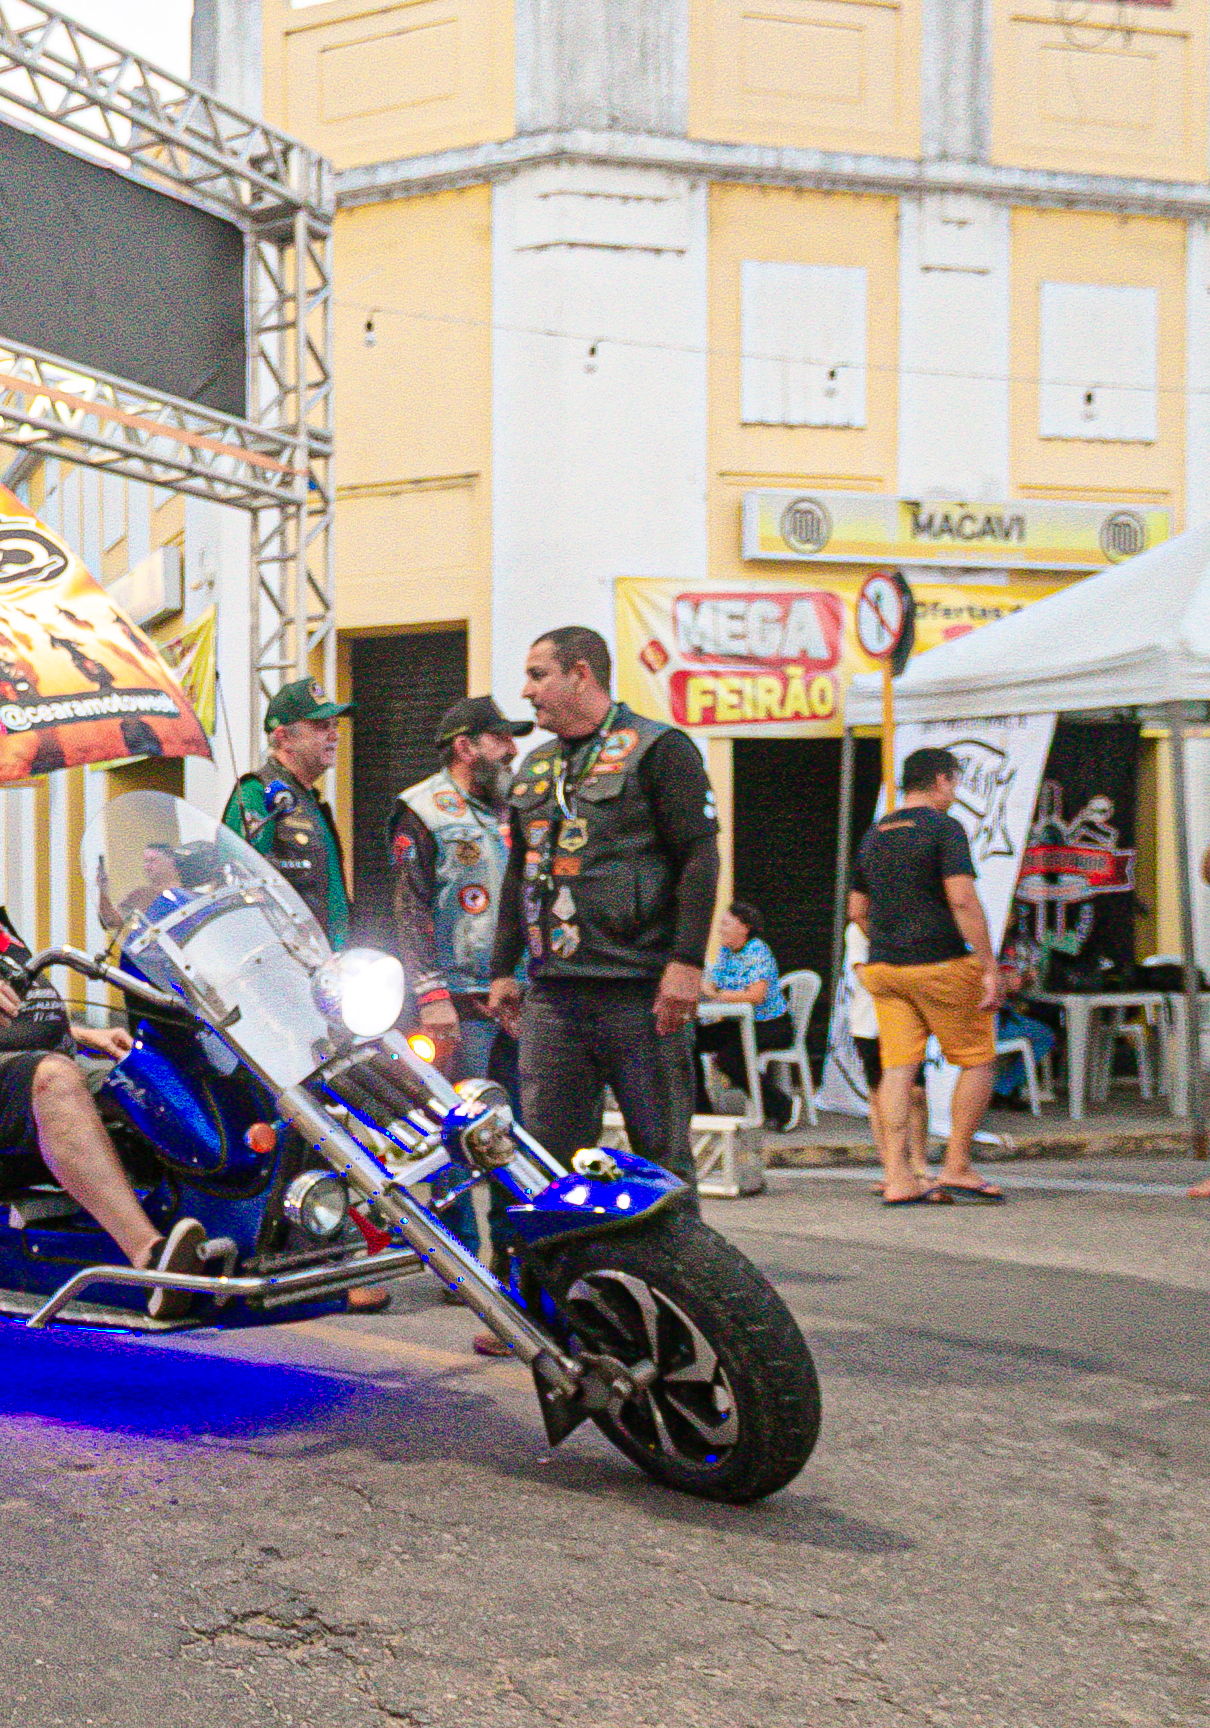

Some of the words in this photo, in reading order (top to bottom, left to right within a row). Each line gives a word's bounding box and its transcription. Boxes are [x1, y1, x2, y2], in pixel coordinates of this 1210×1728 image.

[910, 509, 1026, 543] MACAVI
[675, 598, 831, 660] MEGA
[685, 665, 835, 724] FEIRÃO
